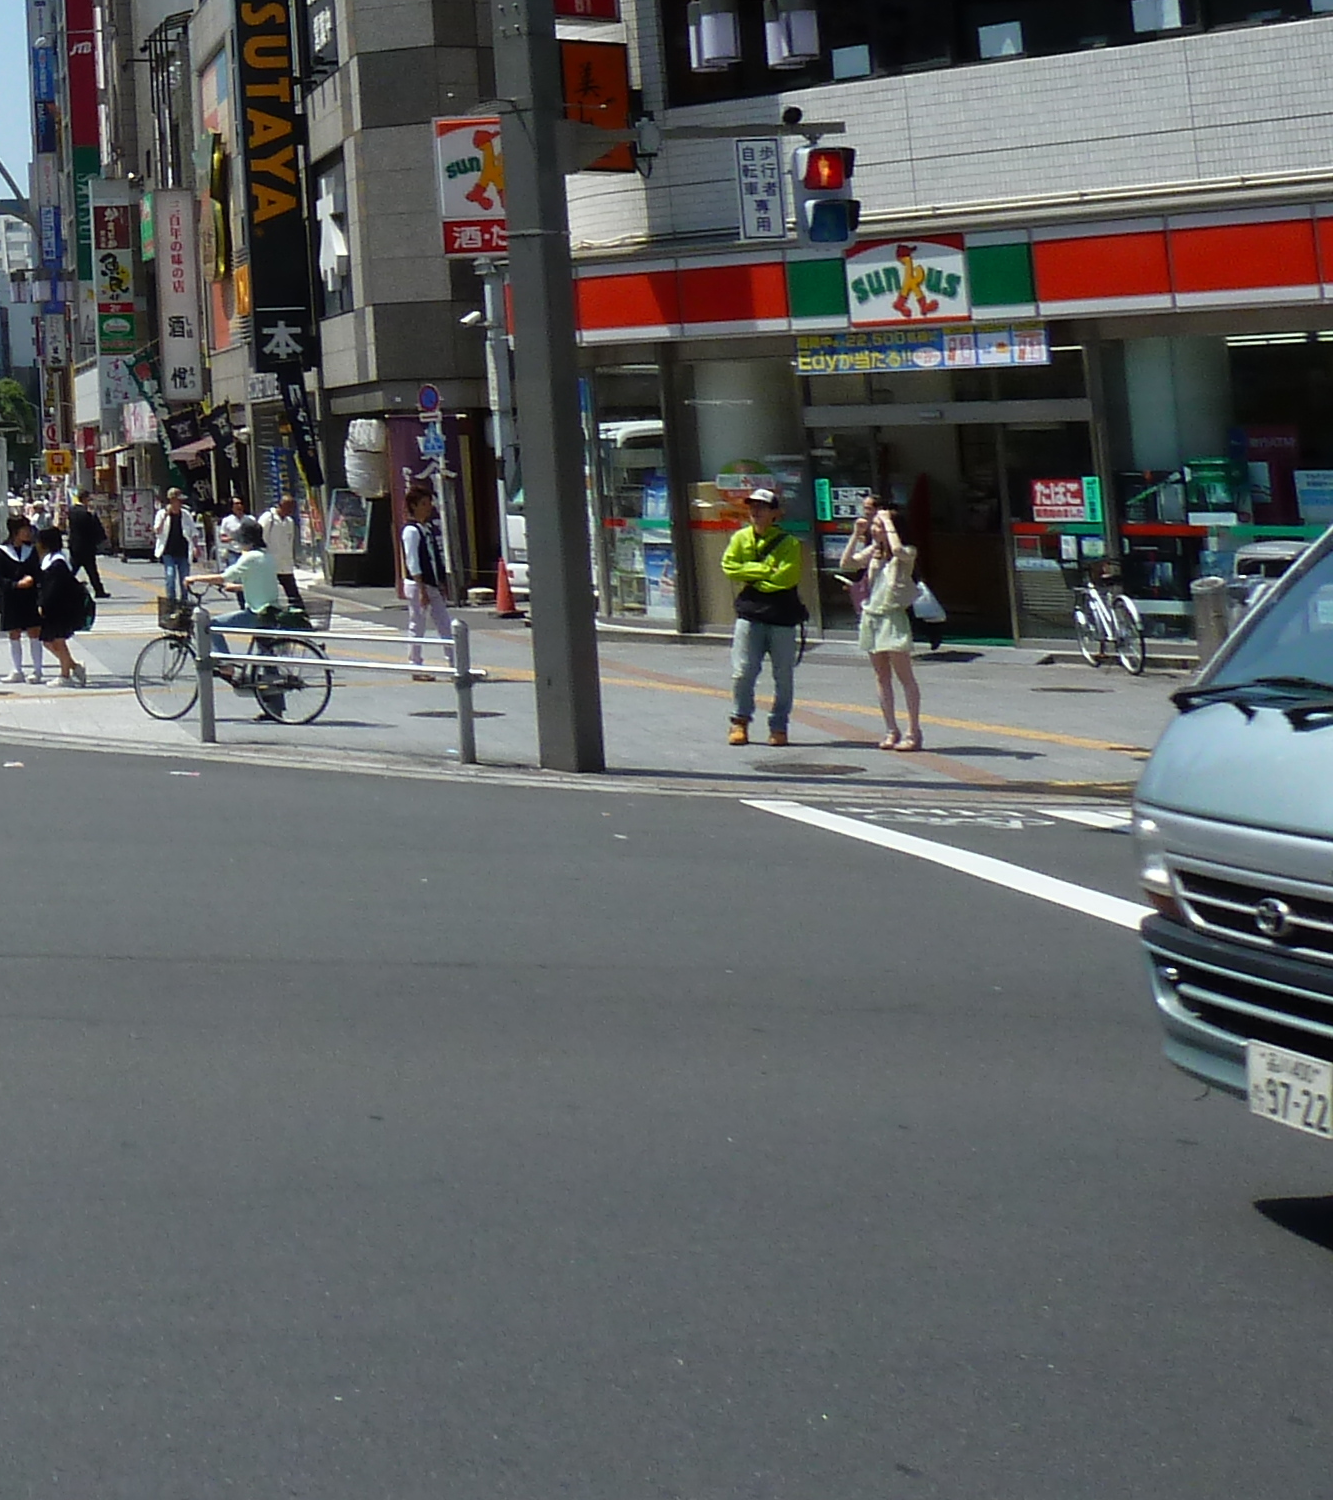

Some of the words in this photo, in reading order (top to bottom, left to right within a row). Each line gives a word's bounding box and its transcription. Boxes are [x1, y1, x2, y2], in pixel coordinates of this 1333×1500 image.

[69, 40, 94, 57] JTB
[740, 146, 760, 198] 自転車
[758, 145, 777, 198] 歩行者
[753, 198, 773, 234] 専用
[99, 252, 130, 294] 魚民
[849, 243, 963, 318] sunkus
[166, 314, 188, 391] 酒悦
[260, 318, 305, 361] 本
[1033, 479, 1083, 506] たばこ
